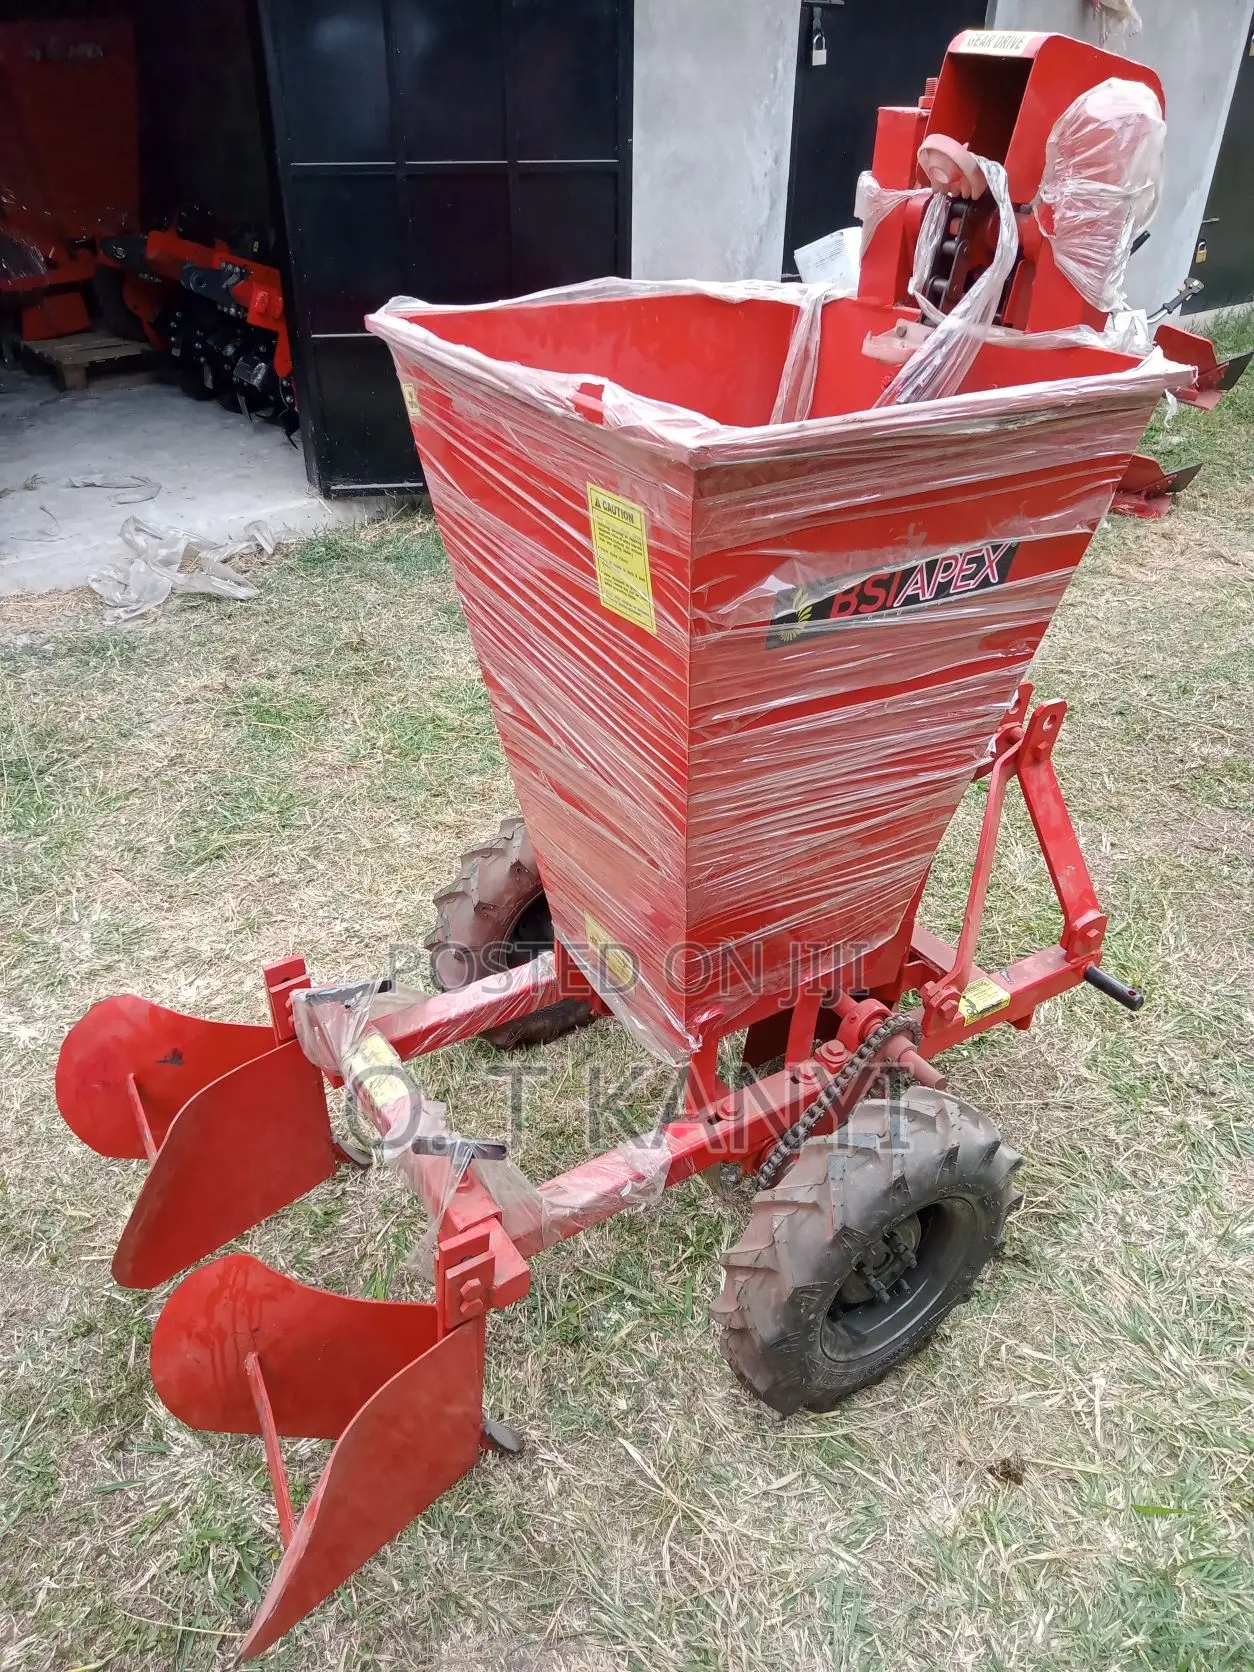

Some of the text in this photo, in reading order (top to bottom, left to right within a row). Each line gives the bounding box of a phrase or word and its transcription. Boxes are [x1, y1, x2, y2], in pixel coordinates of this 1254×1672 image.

[967, 33, 1026, 50] GEAR DRIVE
[602, 500, 634, 524] CAUTION
